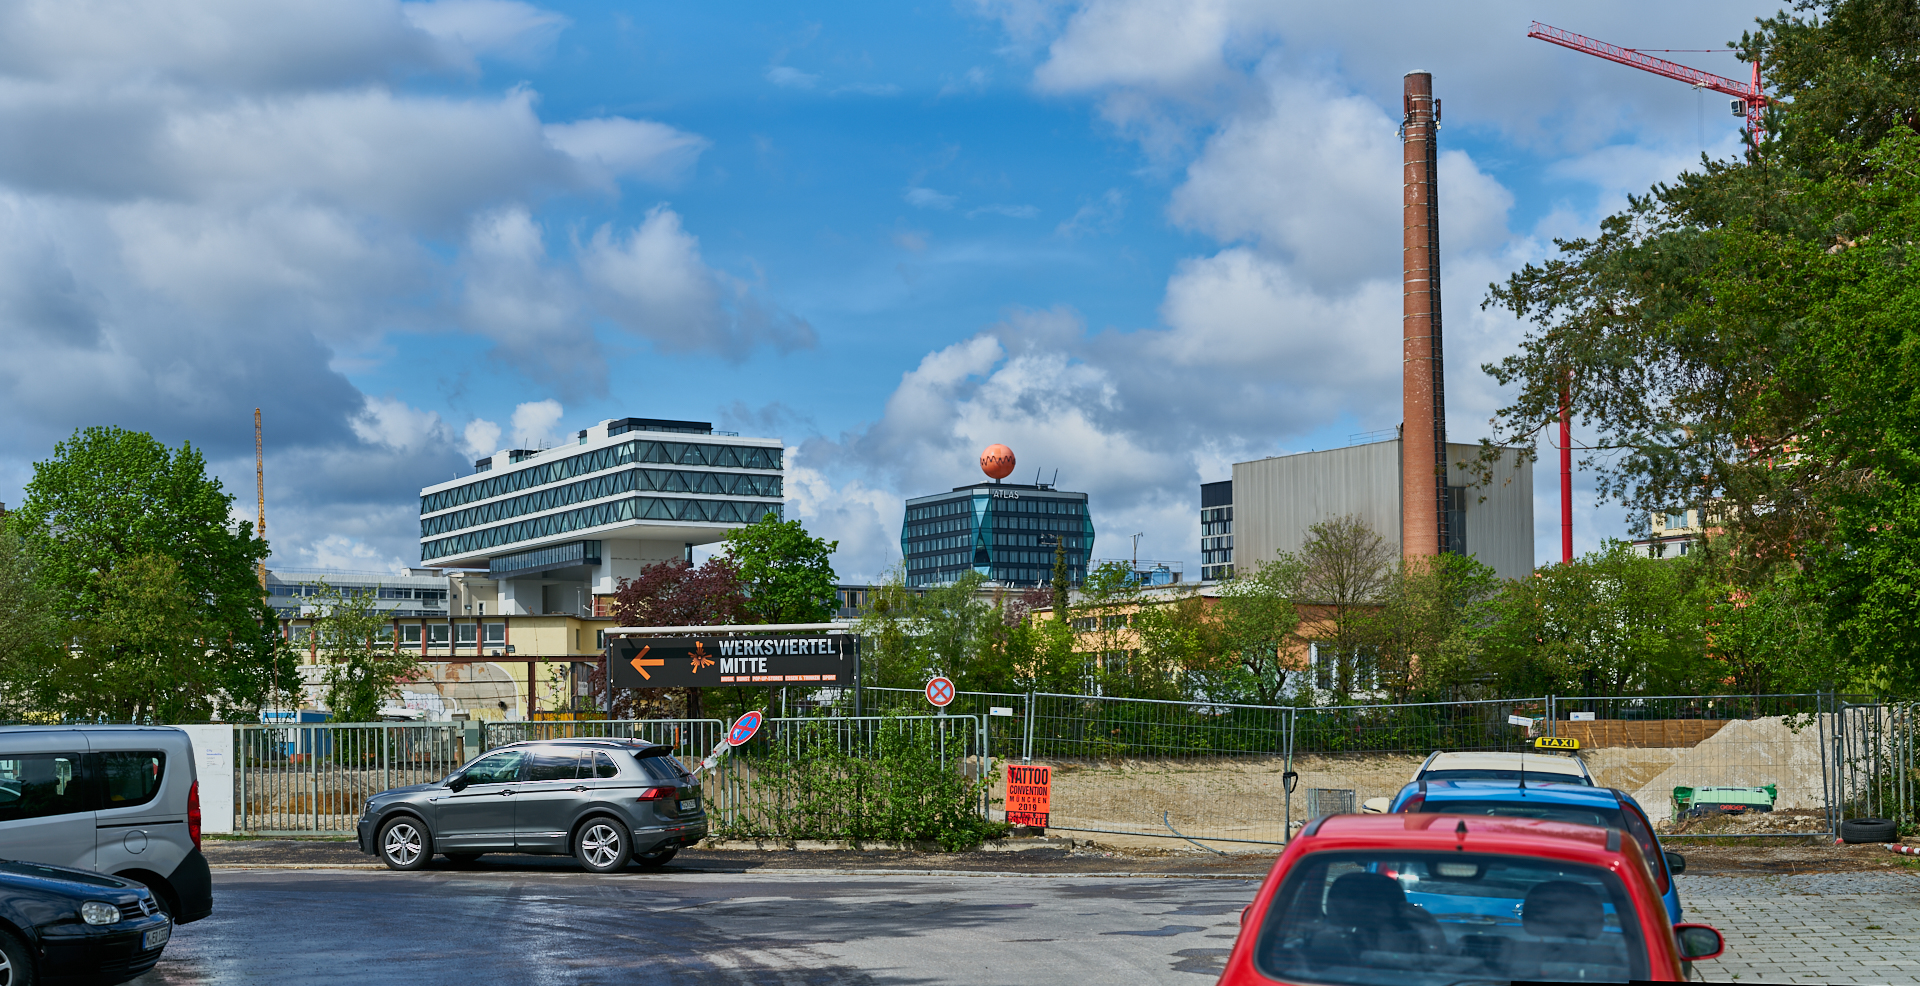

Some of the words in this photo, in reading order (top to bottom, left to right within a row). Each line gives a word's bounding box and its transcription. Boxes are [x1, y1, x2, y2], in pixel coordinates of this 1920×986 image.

[993, 490, 1019, 499] ATLAS
[719, 638, 836, 655] WERKSVIERTEL
[720, 657, 768, 674] MITTE
[1543, 739, 1573, 747] TAXI
[1010, 767, 1048, 785] TATTOO
[1010, 785, 1048, 796] CONVENTION
[1009, 795, 1047, 804] MÜNCHEN
[1018, 803, 1037, 811] 2019
